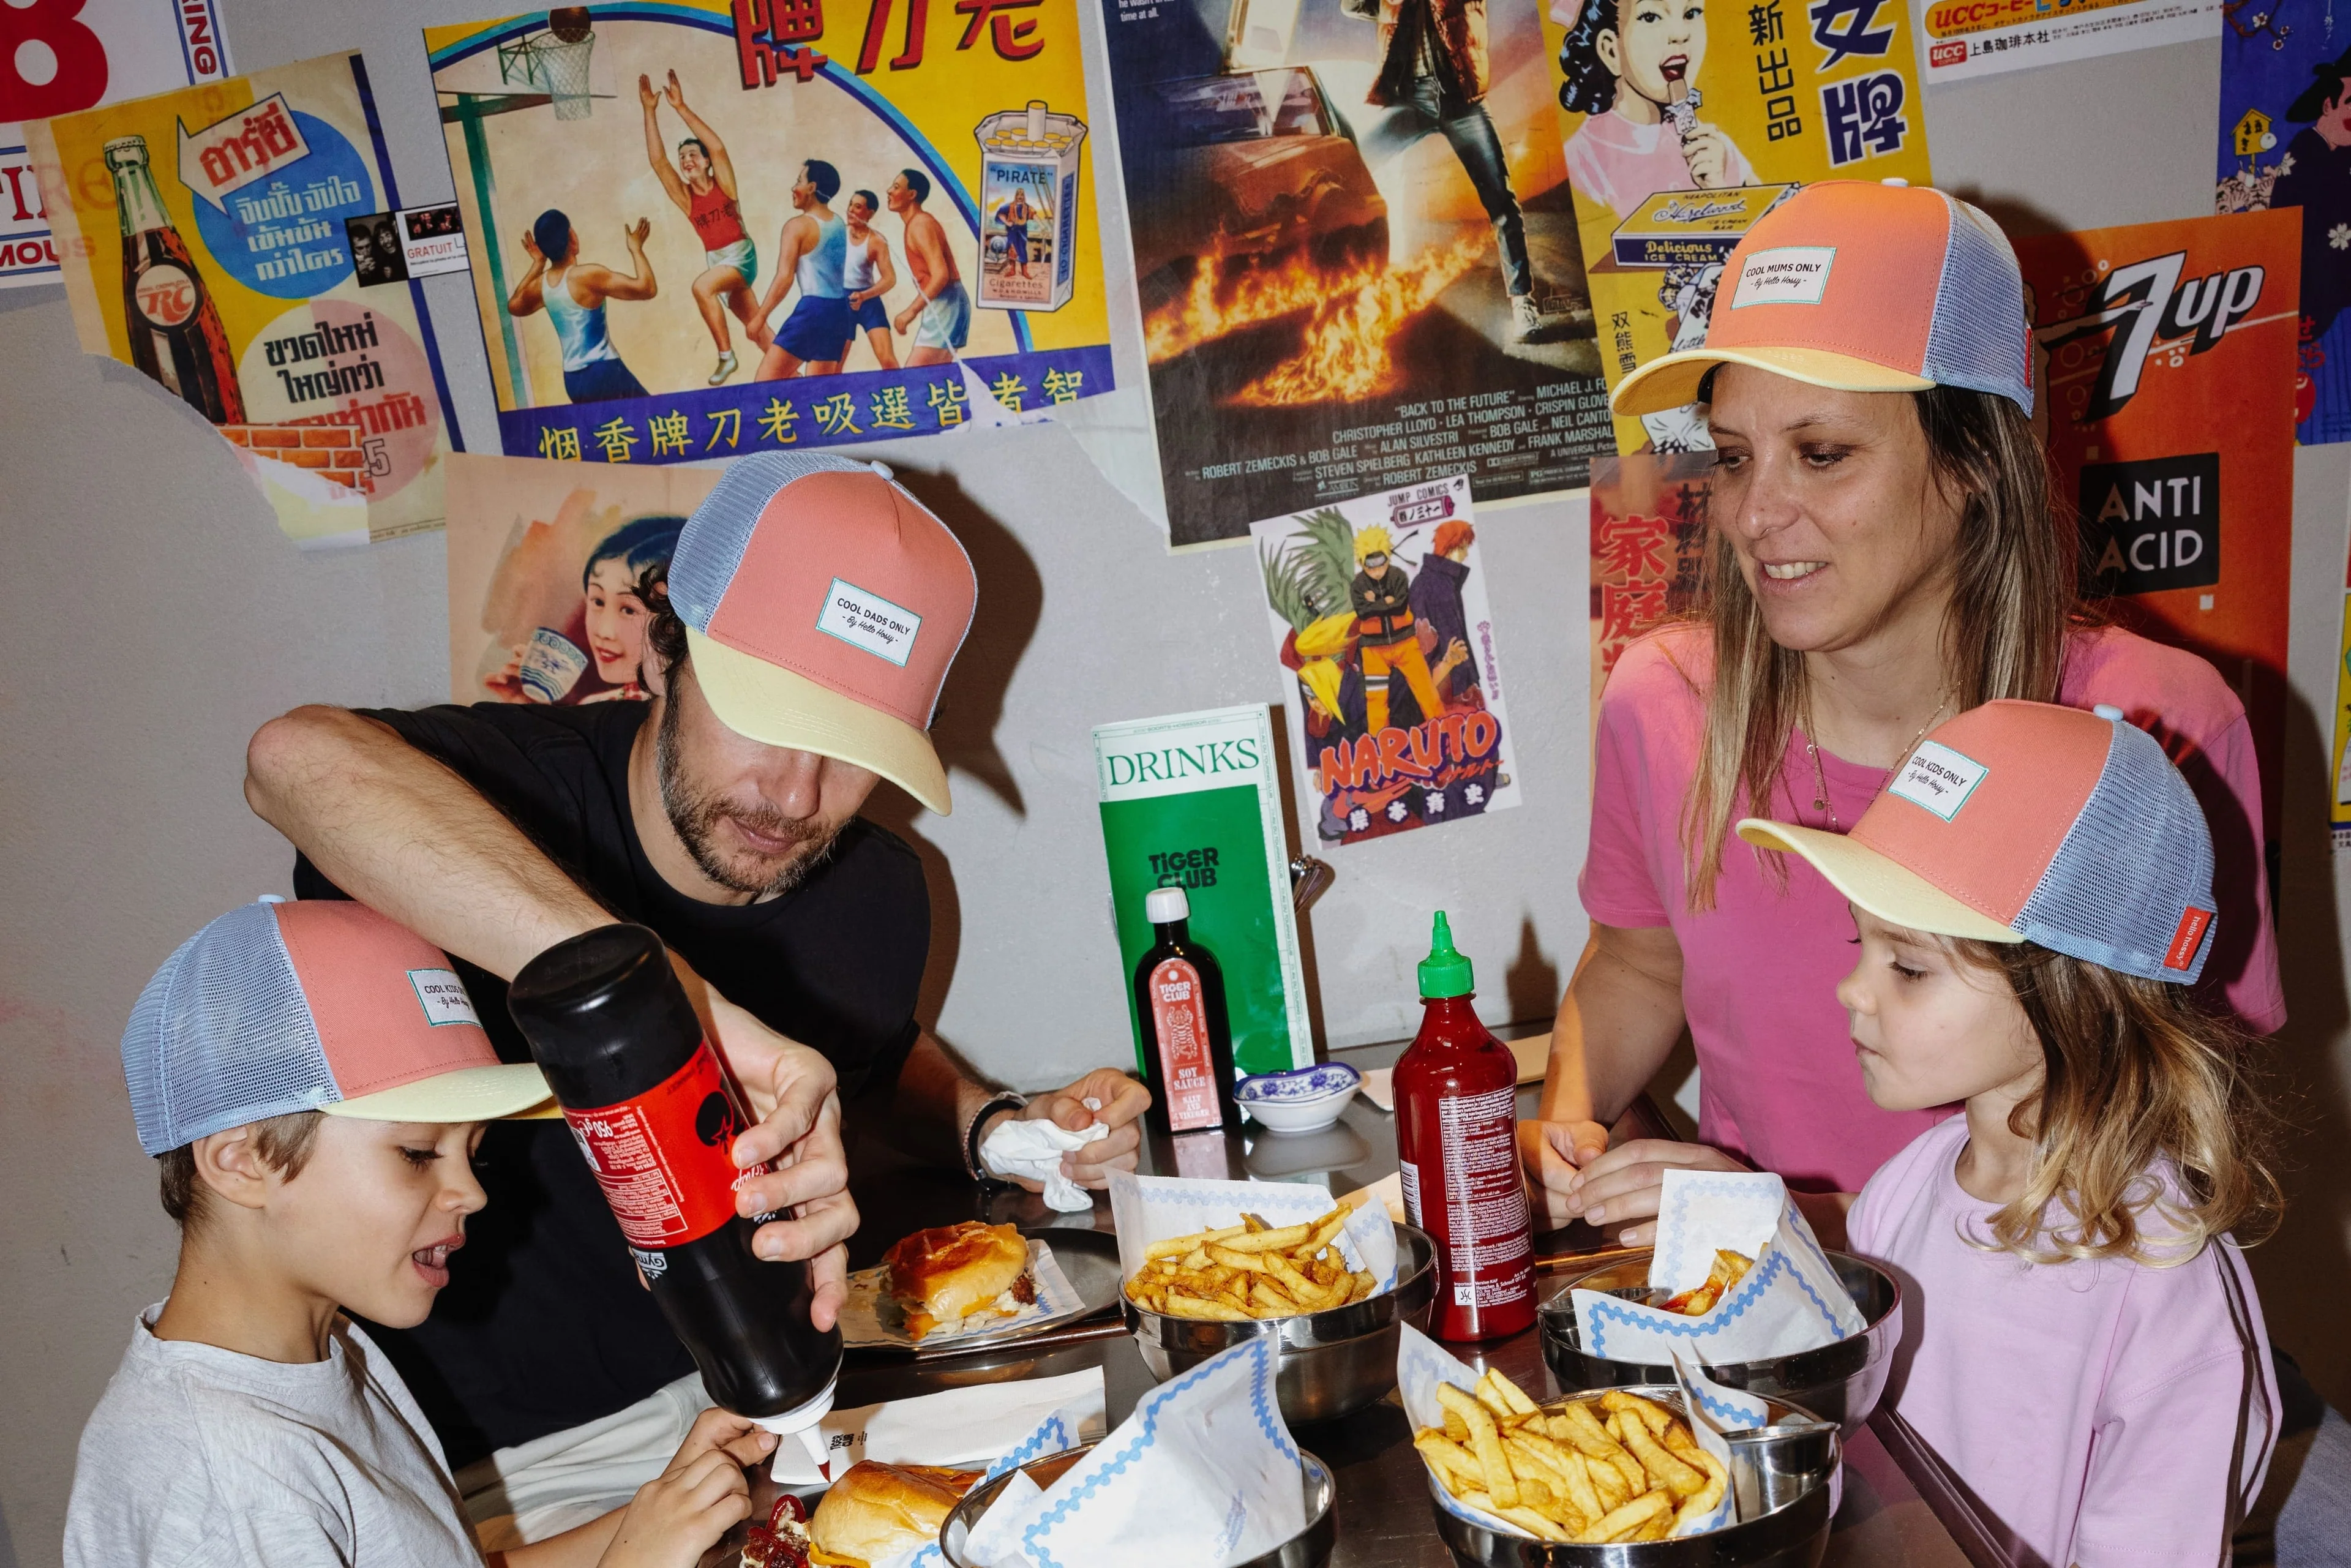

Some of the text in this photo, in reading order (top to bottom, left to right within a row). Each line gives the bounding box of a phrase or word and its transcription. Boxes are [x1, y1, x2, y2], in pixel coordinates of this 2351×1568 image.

[1120, 7, 1159, 22] time at all.
[182, 0, 216, 75] ING
[1748, 0, 1802, 141] 新出品
[407, 242, 452, 259] GRATUIT
[1645, 240, 1713, 253] Delicious
[1746, 263, 1821, 277] COOL MUMS ONLY
[1754, 276, 1801, 290] By Hello Hossy
[1430, 400, 1445, 414] TO
[1447, 397, 1468, 411] THE
[1536, 381, 1582, 399] MICHAEL
[1584, 380, 1594, 392] J.
[1333, 394, 1610, 444] CHRISTOPHER LLOYD LEA THOMPSON CRISPIN GLOVE
[1202, 461, 1242, 480] ROBERT
[1245, 454, 1297, 474] ZEMECKIS
[1299, 455, 1307, 465] &
[1308, 449, 1330, 465] BOB
[1332, 445, 1358, 460] GALE
[1381, 438, 1408, 454] ALAN
[1410, 430, 1460, 449] SILVESTRI
[1490, 422, 1512, 438] BOB
[1513, 419, 1539, 435] GALE
[1551, 415, 1575, 429] NEIL
[1577, 409, 1612, 427] CANTO
[1314, 462, 1354, 480] STEVEN
[1356, 454, 1412, 473] SPIELBERG
[1414, 446, 1466, 465] KATHLEEN
[1469, 438, 1515, 456] KENNEDY
[1528, 432, 1563, 449] FRANK
[1565, 425, 1615, 444] MARSHAL
[1558, 445, 1595, 457] UNIVERSAL
[1383, 468, 1422, 486] ROBERT
[1425, 460, 1477, 479] ZEMECKIS
[1387, 483, 1450, 507] JUMP COMICS
[2098, 476, 2201, 523] ANTI
[2096, 529, 2203, 576] ACID
[837, 598, 910, 635] COOL DADS ONLY
[847, 616, 894, 644] By Hello Hossy
[1106, 738, 1259, 786] DRINKS
[1320, 710, 1498, 796] NARUTO
[1911, 756, 1967, 787] COOL KIDS ONLY
[1916, 773, 1929, 784] Hello
[1929, 779, 1945, 796] Hossy
[1157, 867, 1217, 890] CLUB
[2187, 915, 2202, 936] hello
[424, 984, 459, 994] COOL KIDS
[1163, 991, 1191, 1002] CLUB
[441, 997, 449, 1009] By
[1174, 1076, 1206, 1090] SAUCE
[1178, 1067, 1198, 1079] SOY
[592, 1120, 614, 1138] 950
